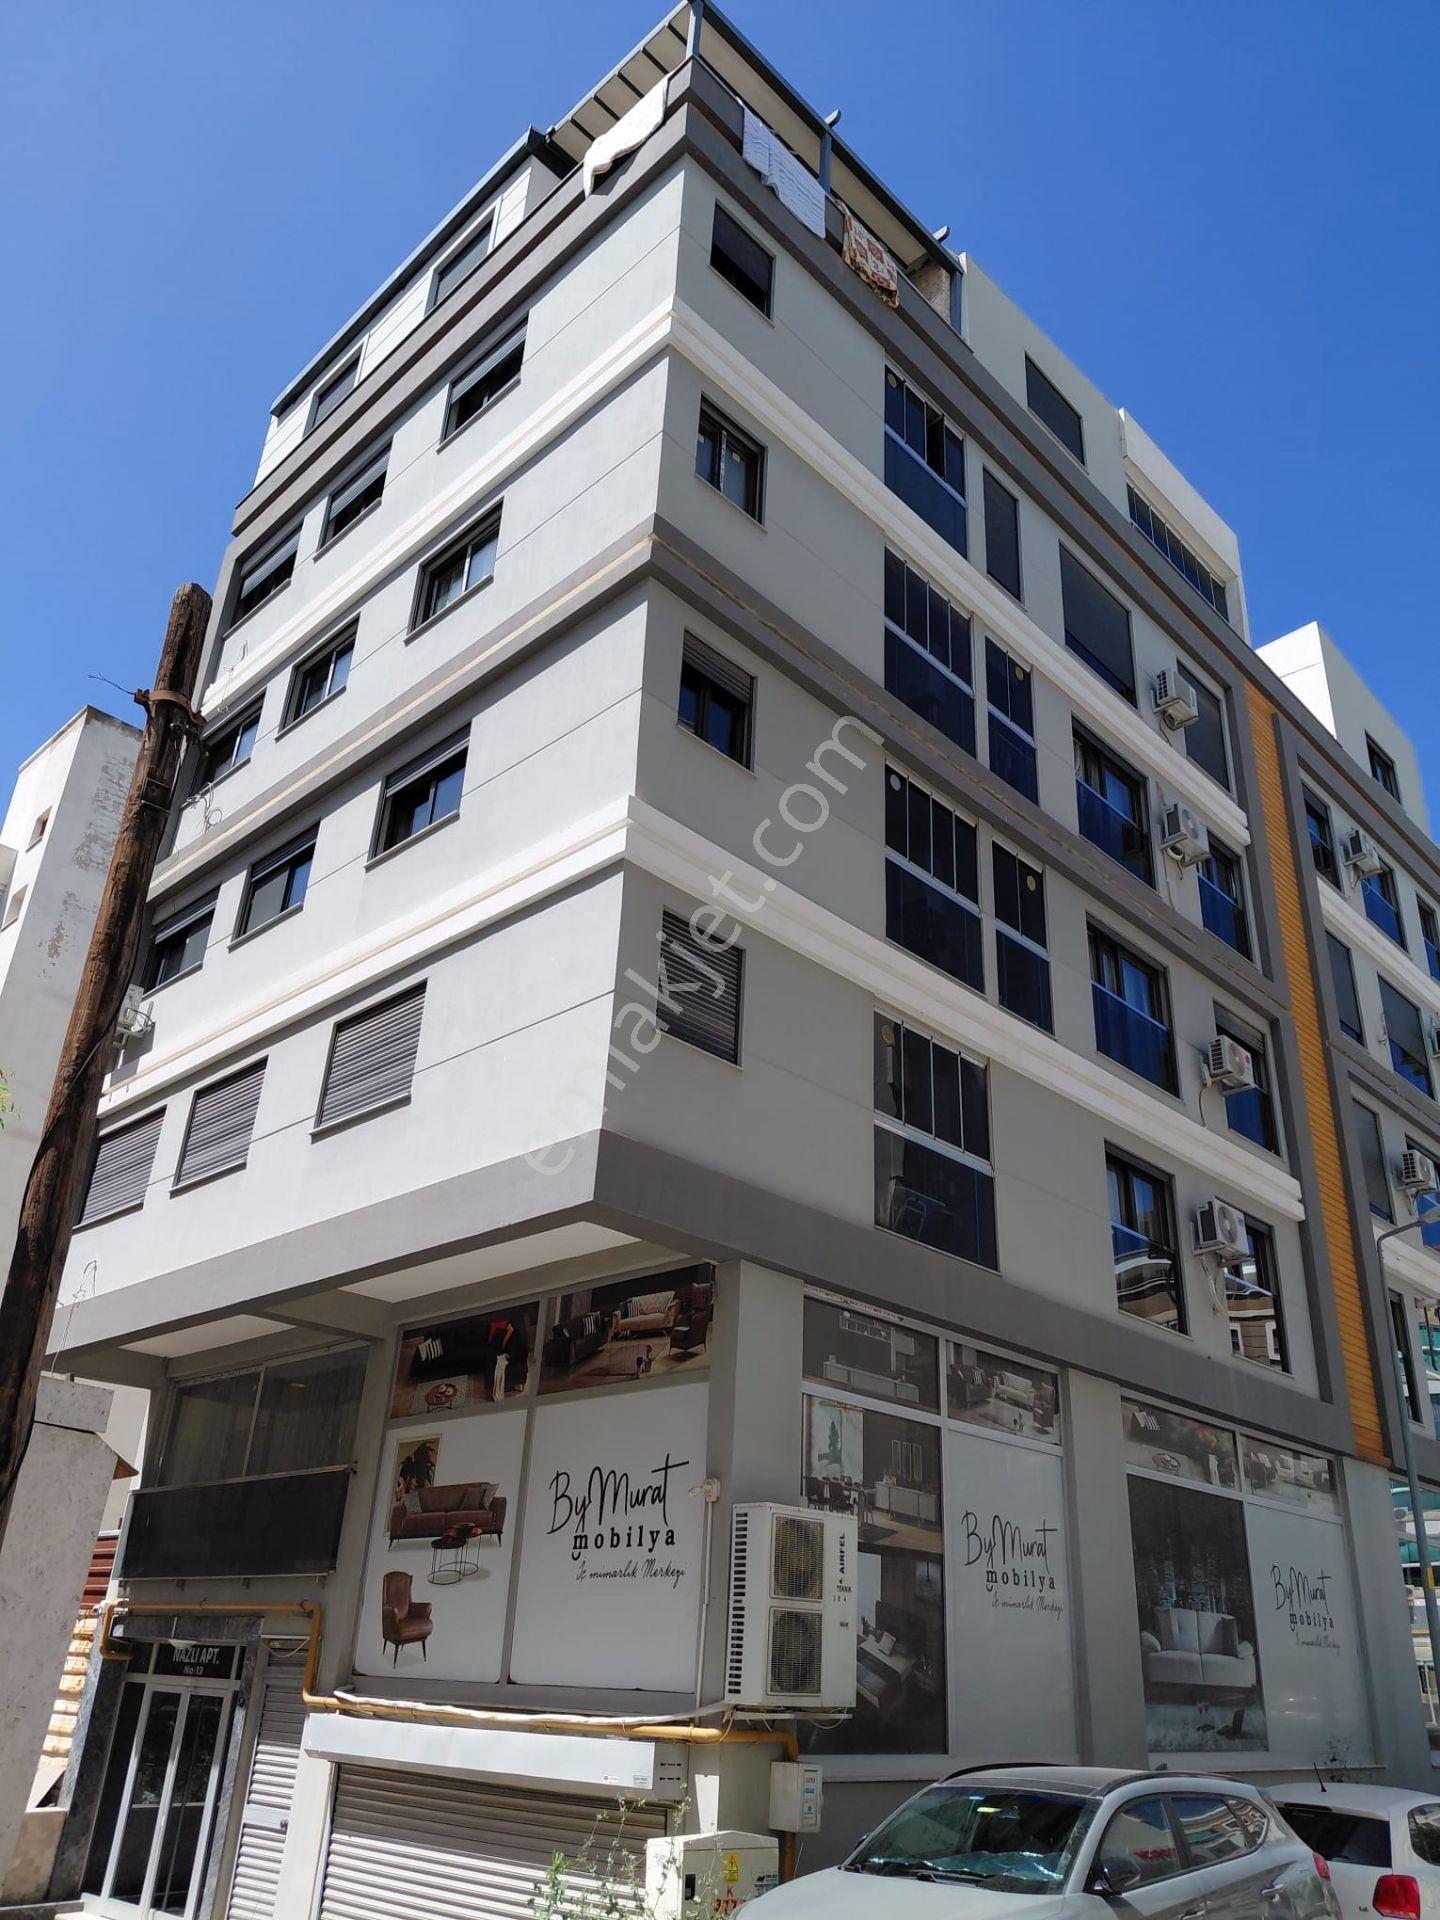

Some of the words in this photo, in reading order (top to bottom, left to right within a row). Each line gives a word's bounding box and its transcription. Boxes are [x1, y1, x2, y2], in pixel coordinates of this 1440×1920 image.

[572, 1525, 675, 1554] mobilya
[986, 1568, 1055, 1593] mobilya
[1290, 1611, 1334, 1632] mobilya
